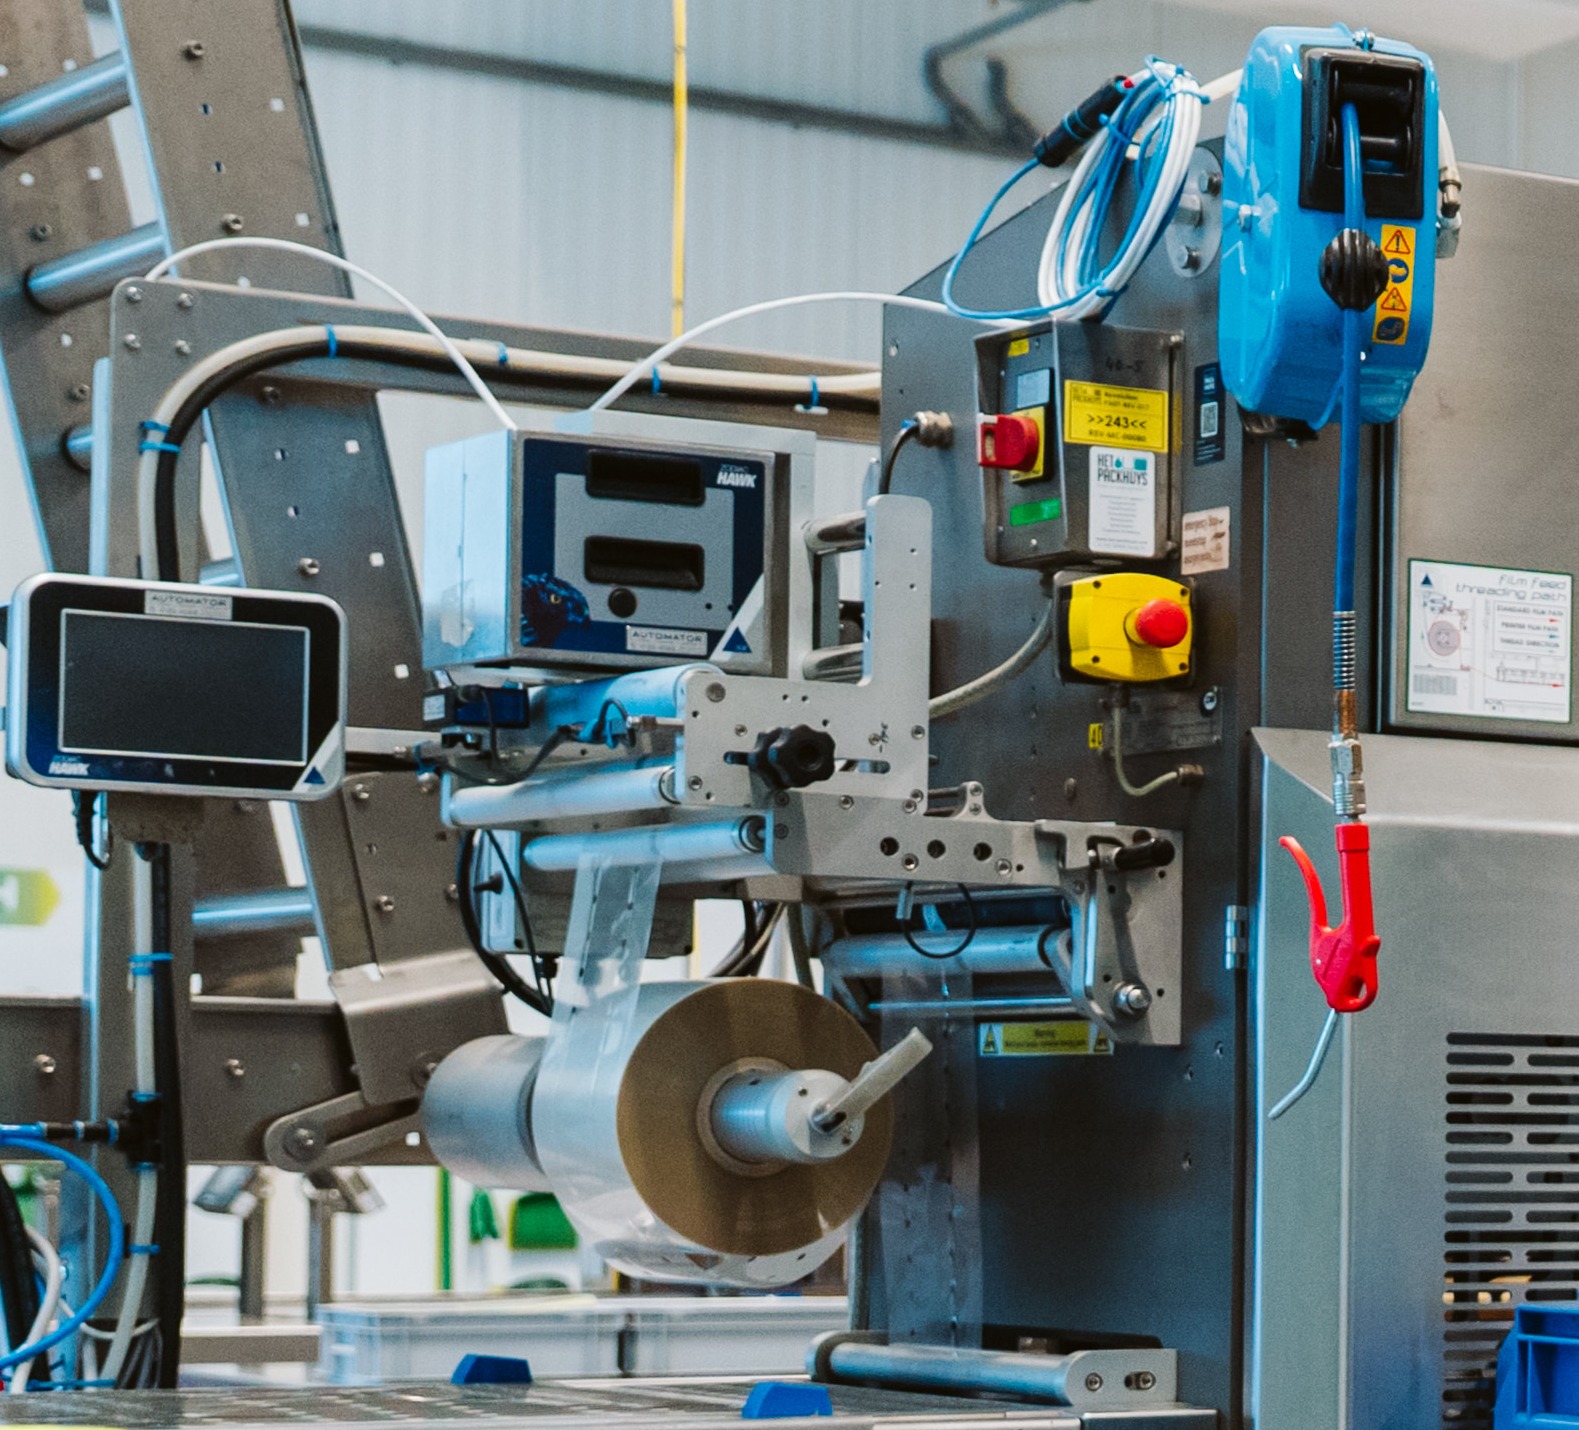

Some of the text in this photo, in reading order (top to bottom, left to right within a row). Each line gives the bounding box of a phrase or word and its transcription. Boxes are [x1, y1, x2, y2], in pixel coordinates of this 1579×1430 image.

[1097, 454, 1114, 467] HET
[717, 471, 757, 488] HAWK
[1097, 468, 1148, 486] PACKHUYS
[1499, 574, 1567, 590] film feed
[1456, 583, 1567, 601] threading path
[632, 631, 702, 643] AUTOMATOR
